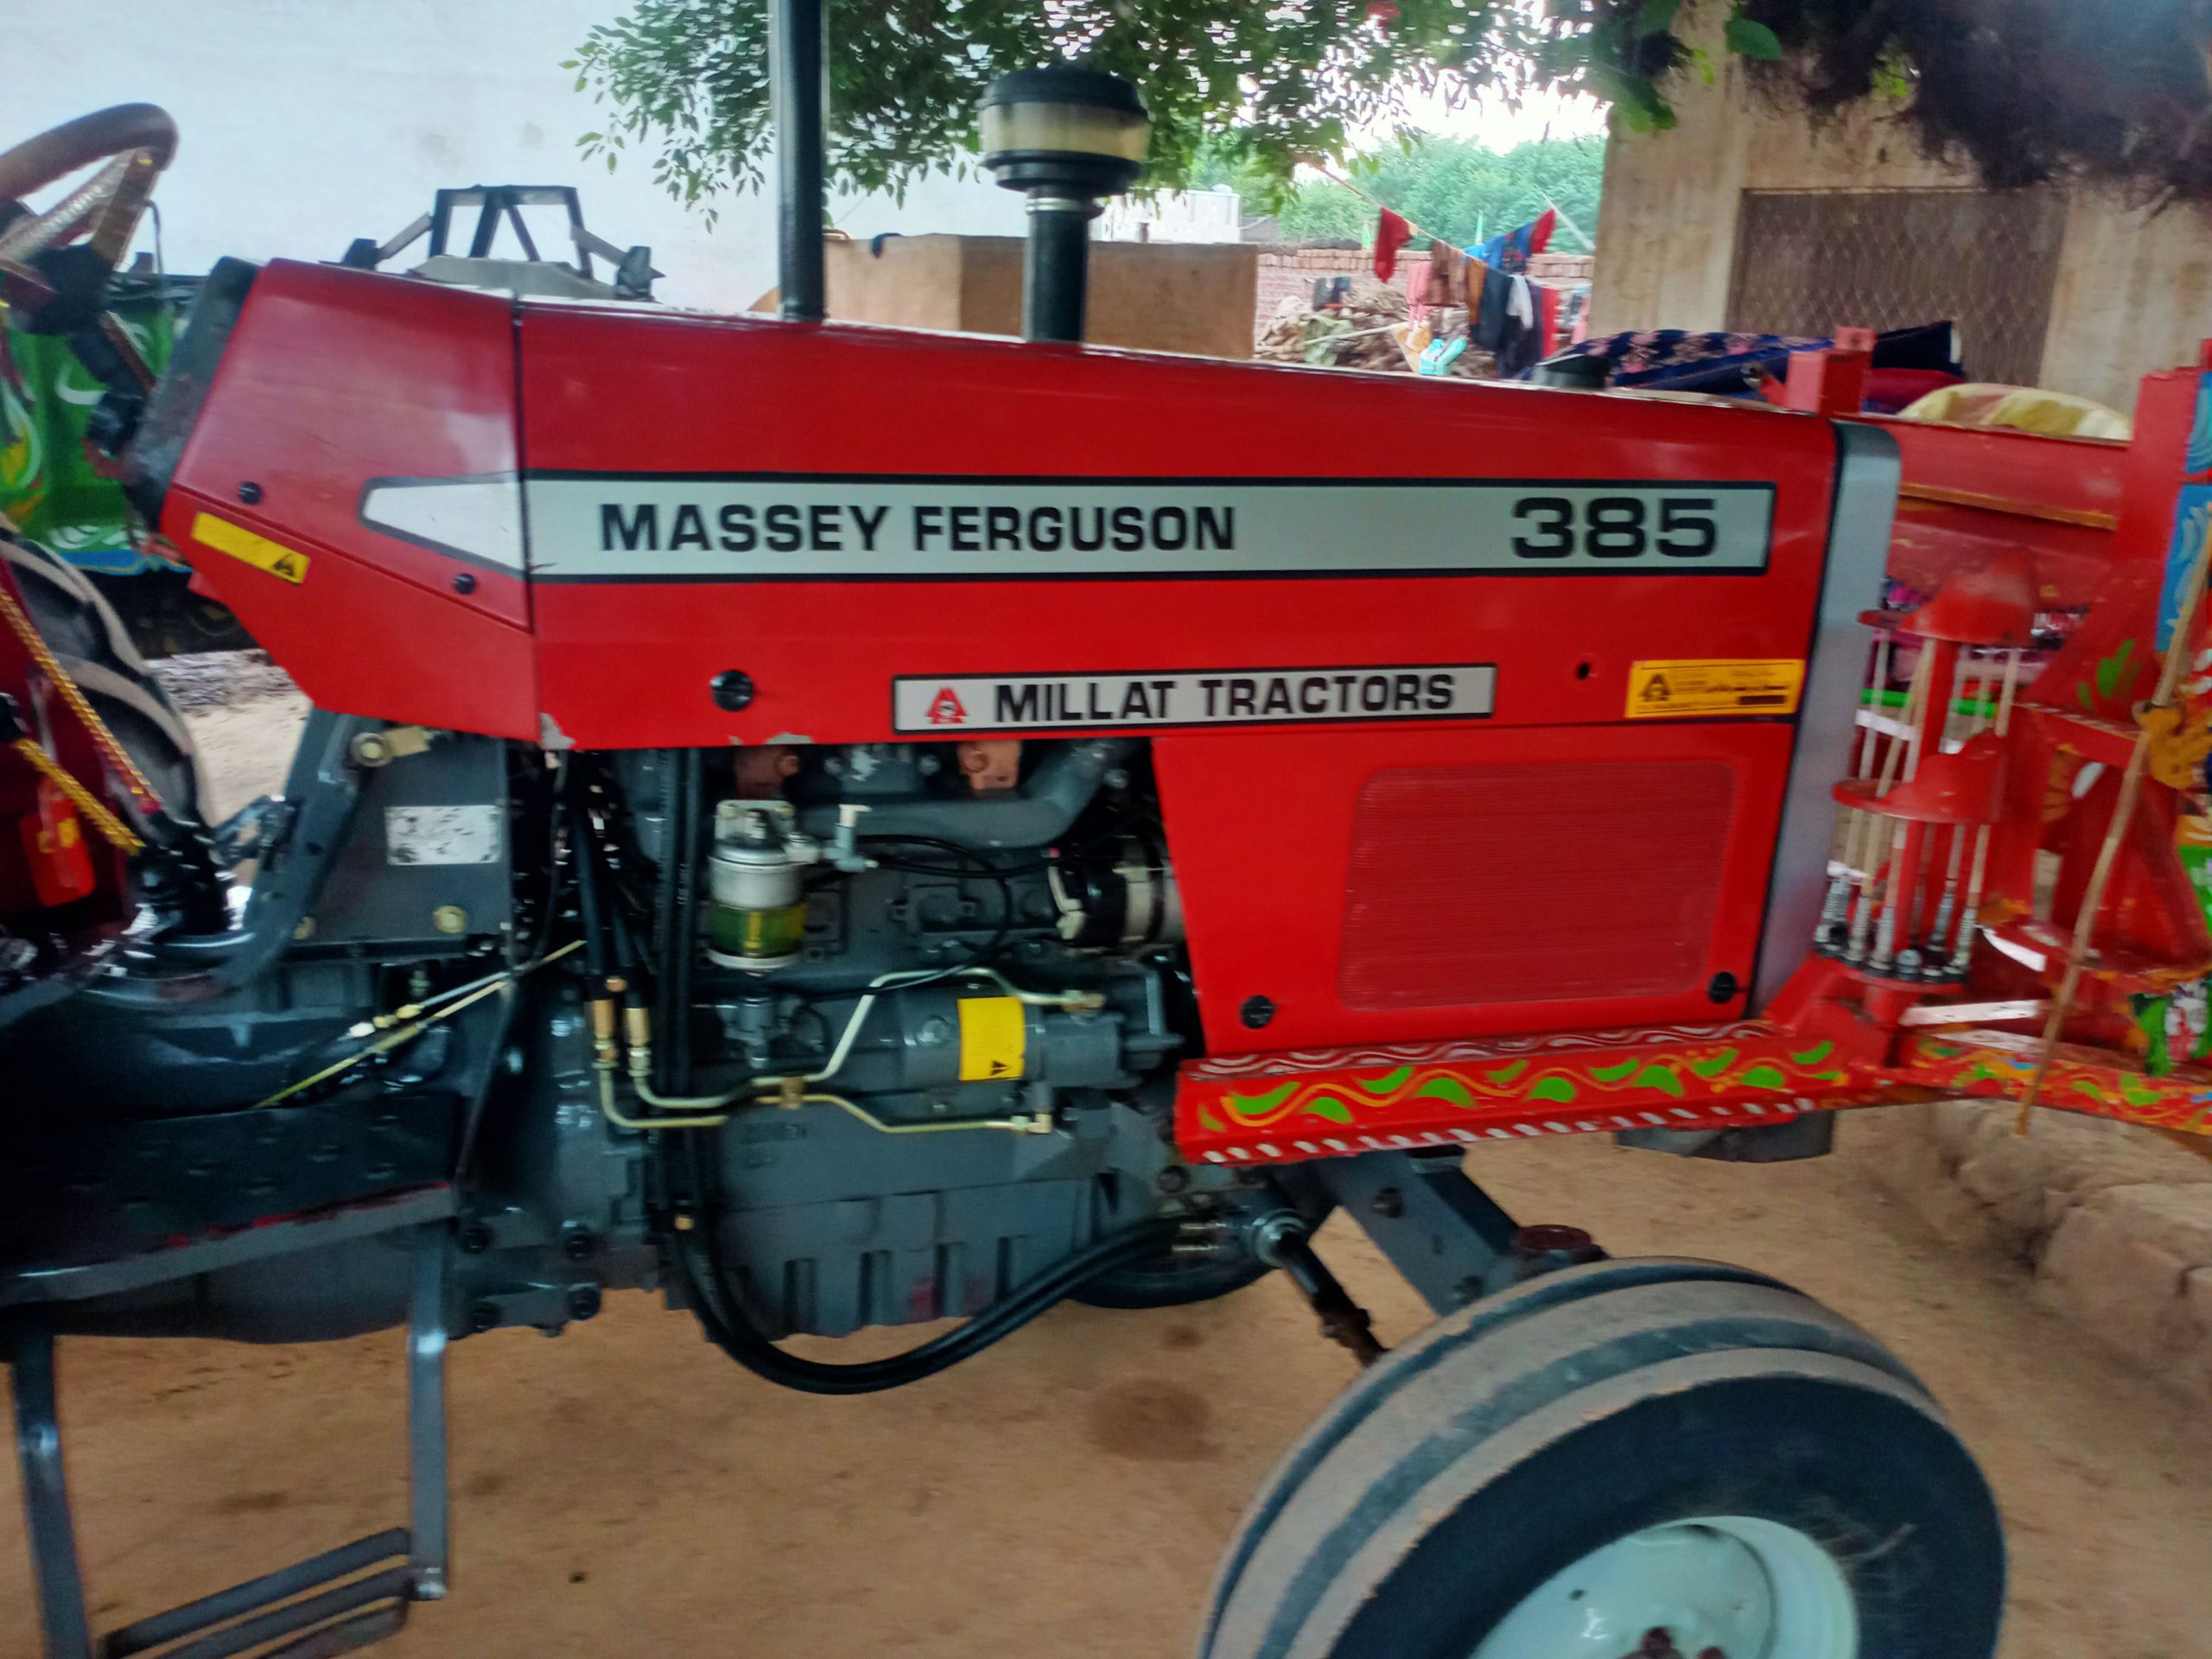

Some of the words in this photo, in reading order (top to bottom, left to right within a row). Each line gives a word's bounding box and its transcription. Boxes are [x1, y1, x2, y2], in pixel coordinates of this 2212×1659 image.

[601, 504, 890, 551] MASSEY
[912, 506, 1234, 551] FERGUSON
[1512, 497, 1718, 558] 385
[995, 681, 1177, 722] MILLAT
[1199, 674, 1454, 716] TRACTORS
